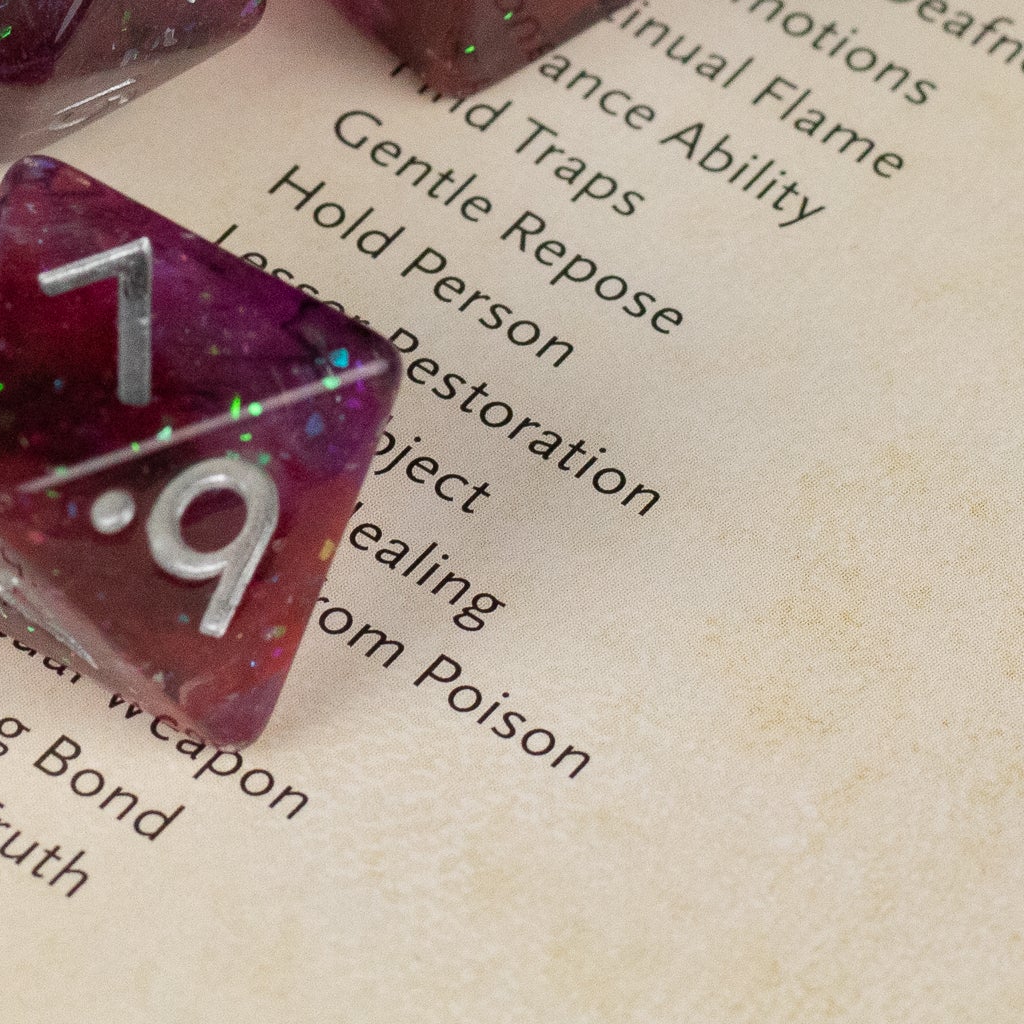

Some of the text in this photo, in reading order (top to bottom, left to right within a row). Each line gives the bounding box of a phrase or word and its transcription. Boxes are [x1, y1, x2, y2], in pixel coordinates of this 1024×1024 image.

[514, 116, 646, 217] Traps
[658, 121, 828, 231] Ability
[751, 75, 908, 181] Flame
[267, 163, 407, 260] Hold
[400, 245, 577, 371] Person
[333, 108, 494, 225] Gentle
[500, 209, 685, 337] Repose
[37, 235, 153, 408] 7
[347, 500, 507, 633] ealing
[412, 652, 595, 783] Poison
[33, 733, 188, 845] Bond
